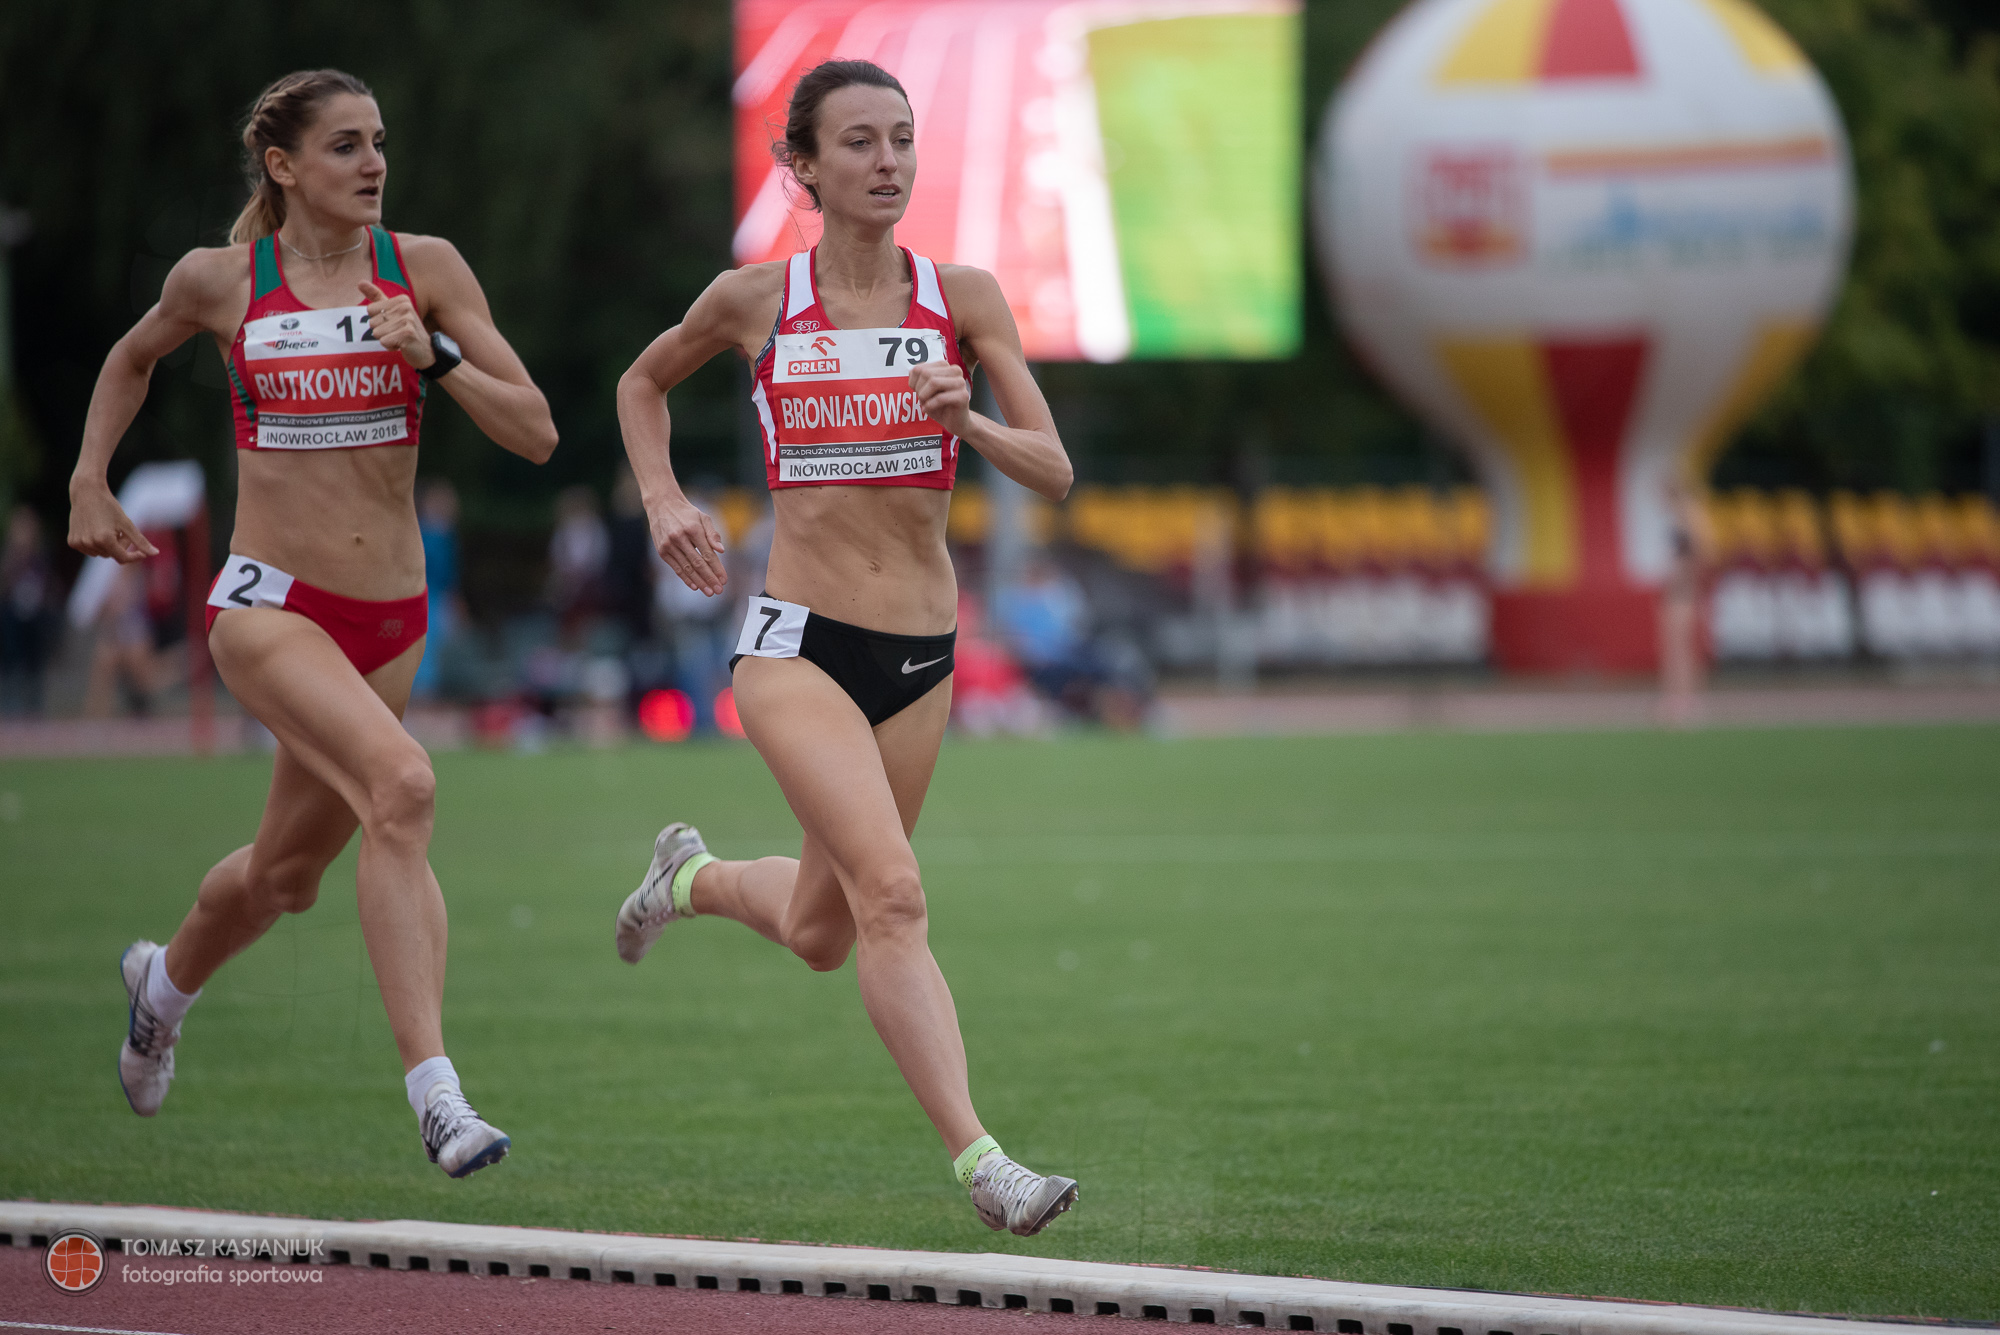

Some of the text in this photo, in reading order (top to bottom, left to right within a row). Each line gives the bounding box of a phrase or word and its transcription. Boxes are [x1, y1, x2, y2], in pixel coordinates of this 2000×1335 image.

[878, 337, 928, 366] 79
[790, 361, 837, 374] ORLEN
[254, 364, 403, 400] RUTKOWSKA
[325, 413, 381, 423] MISTRZOSTWA
[381, 409, 405, 418] POLSKI
[781, 391, 928, 429] BRONIATOWSK
[266, 425, 398, 445] INOWROCŁAW 2018
[801, 446, 853, 455] DRUŻYNOWE
[855, 442, 913, 453] MISTRZOSTWA
[914, 439, 940, 449] POLSKI
[789, 455, 932, 477] INOWROCŁAW 2018
[227, 563, 262, 607] 2
[754, 606, 782, 651] 7
